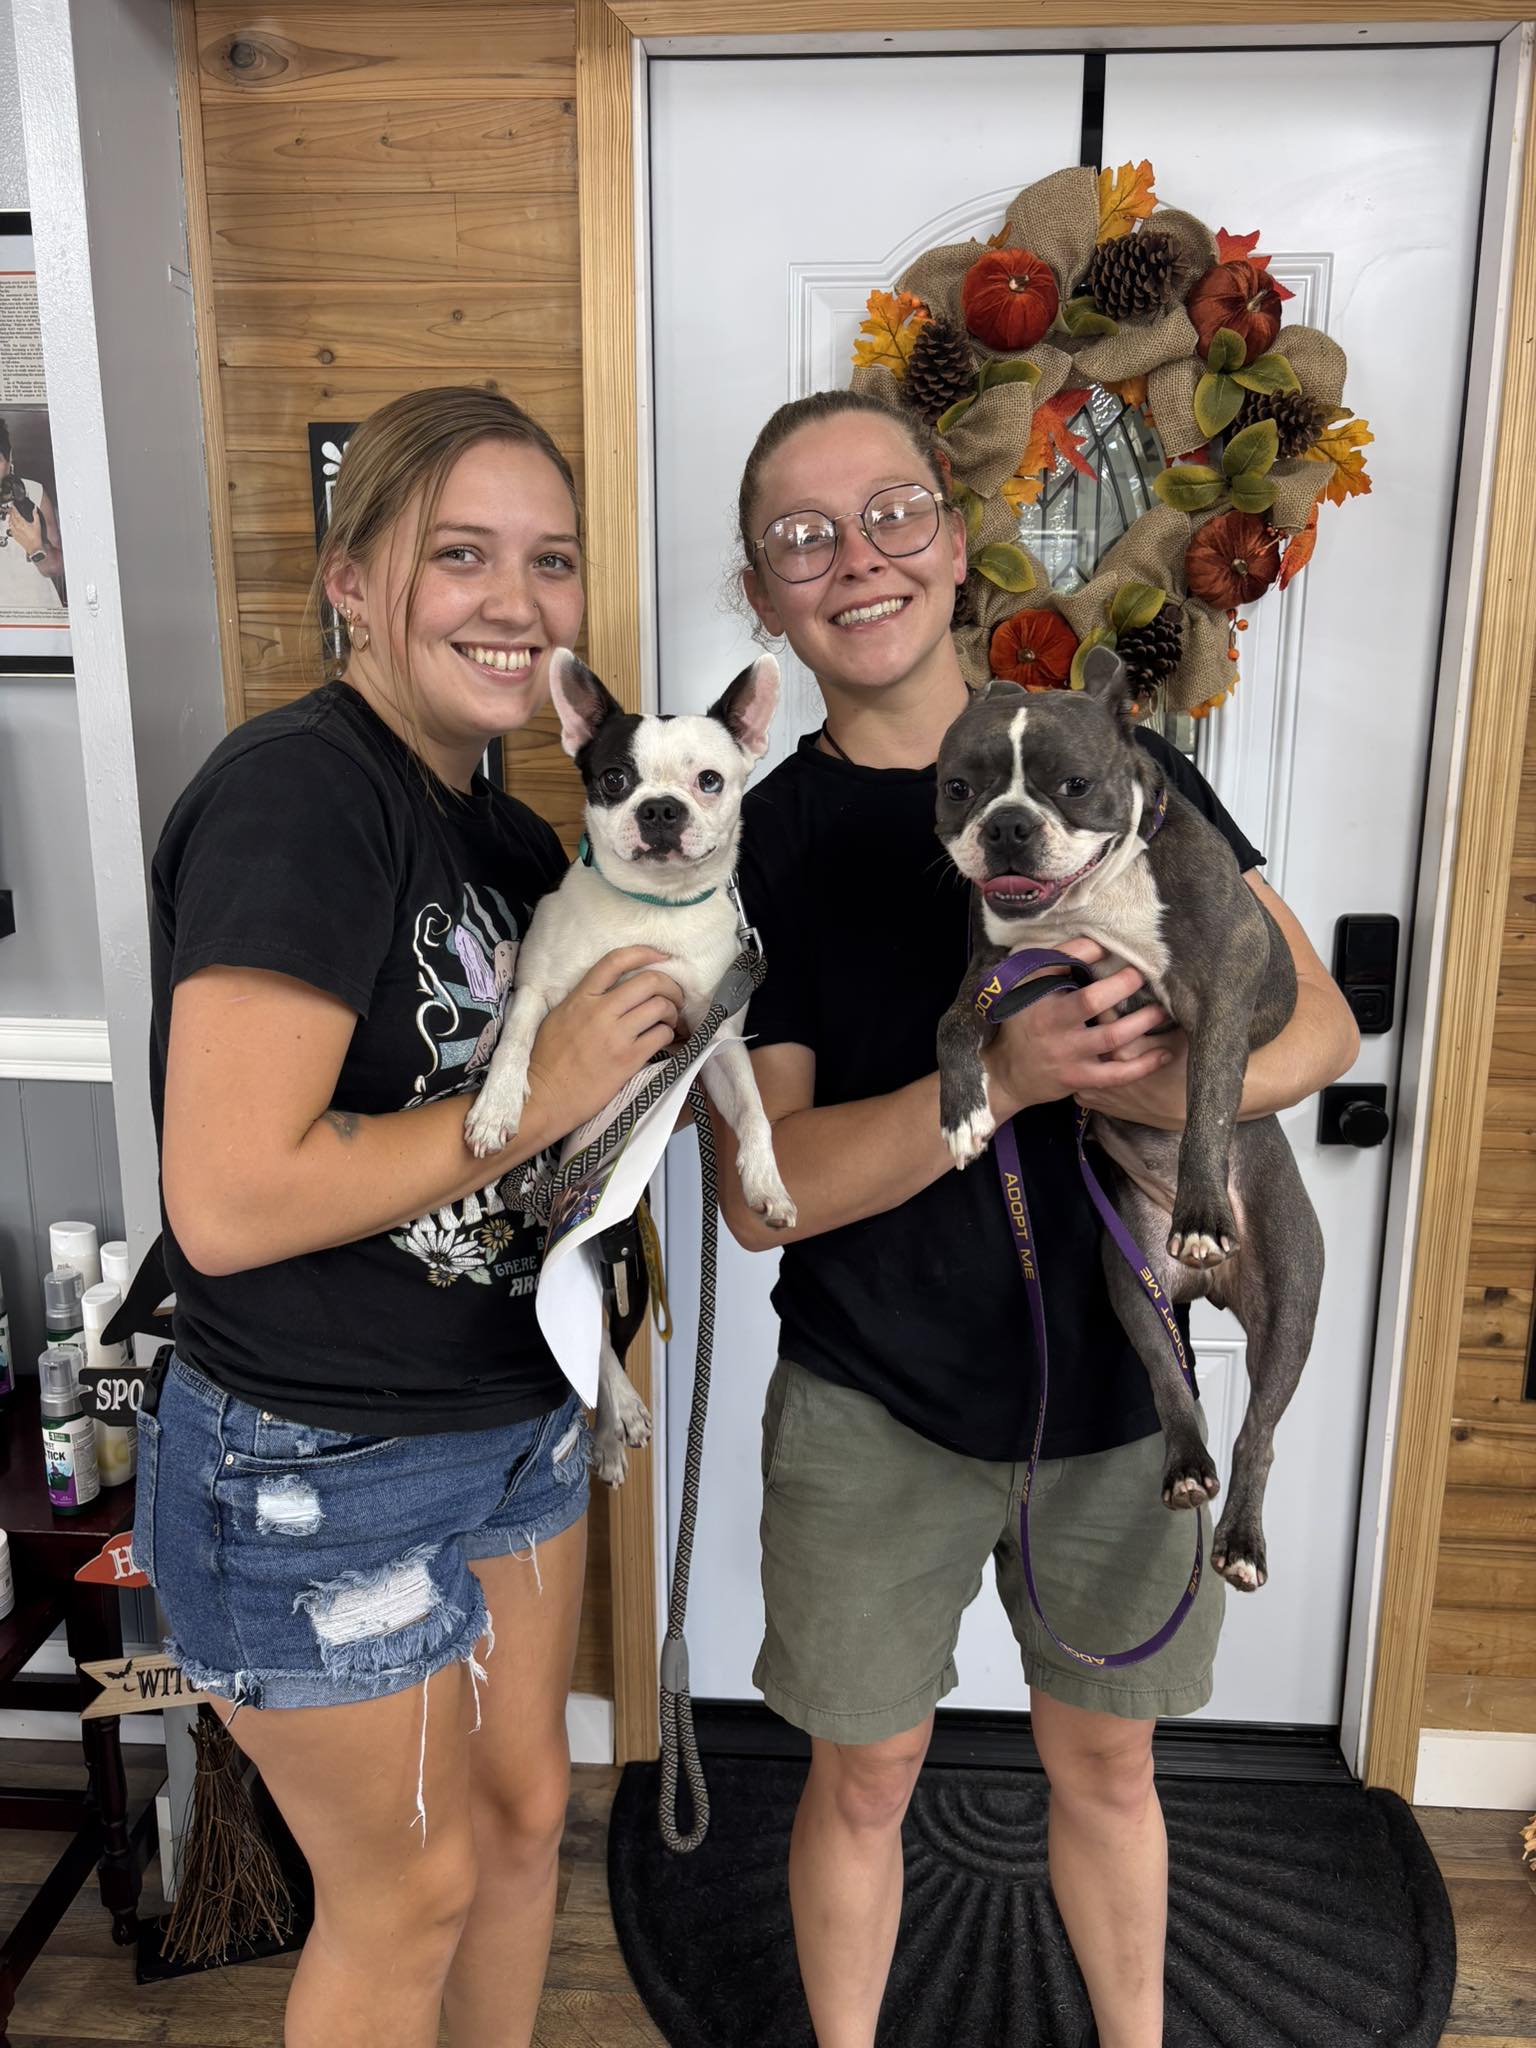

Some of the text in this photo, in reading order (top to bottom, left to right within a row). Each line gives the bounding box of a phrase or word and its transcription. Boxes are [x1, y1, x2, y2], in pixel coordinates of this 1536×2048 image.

[1004, 1172, 1036, 1280] ADOPT ME
[1140, 1266, 1188, 1369] ADOPT ME
[95, 1378, 145, 1412] SPO
